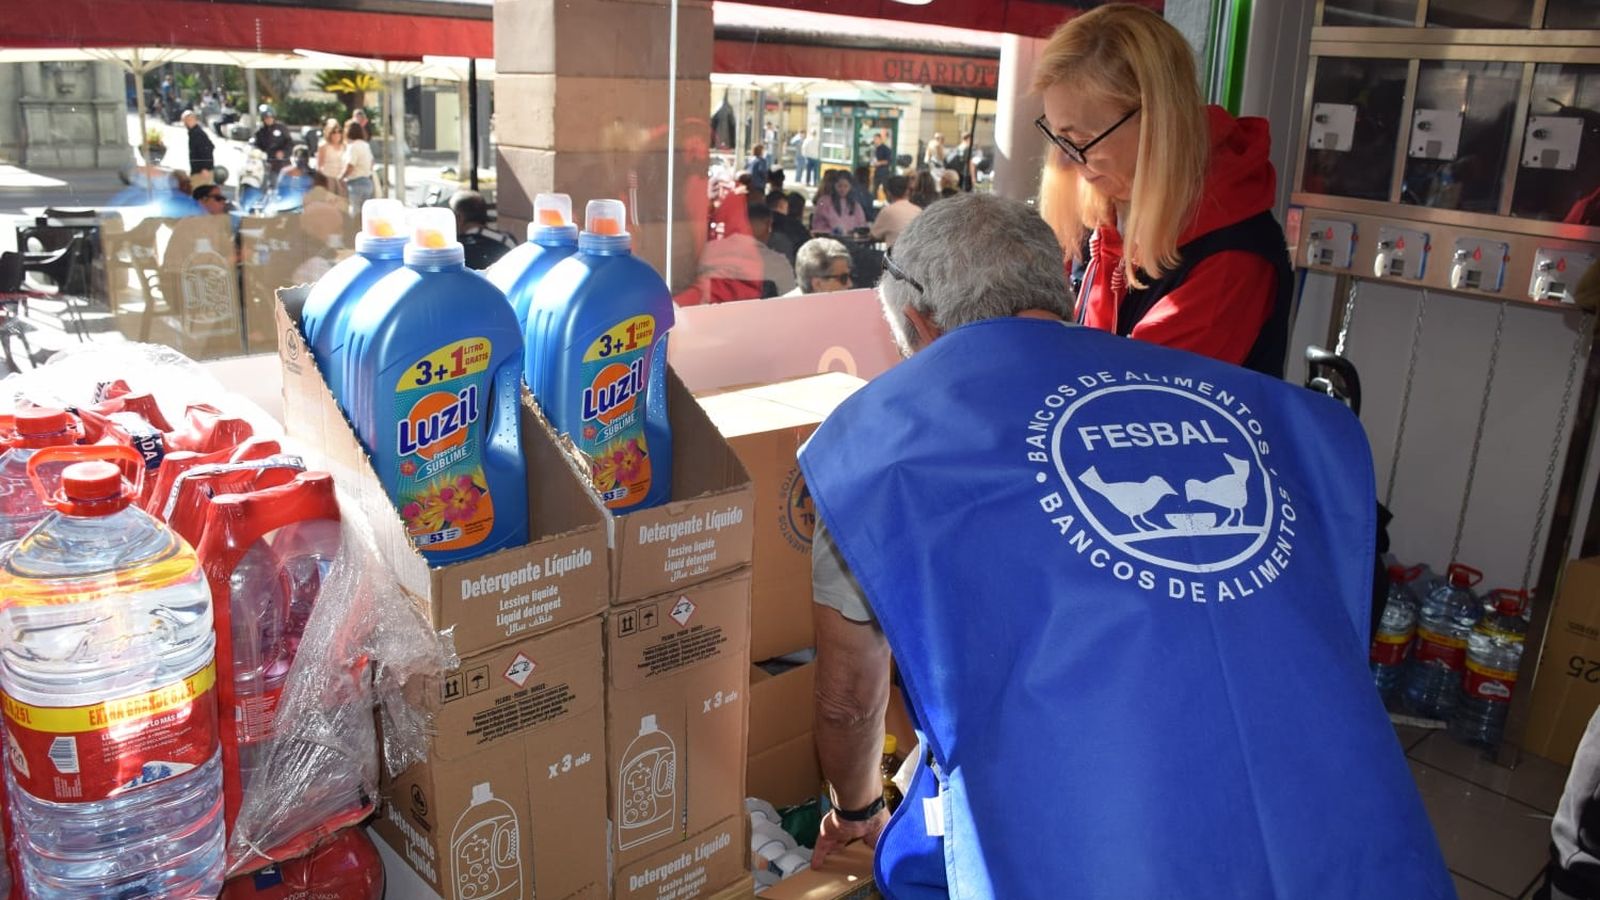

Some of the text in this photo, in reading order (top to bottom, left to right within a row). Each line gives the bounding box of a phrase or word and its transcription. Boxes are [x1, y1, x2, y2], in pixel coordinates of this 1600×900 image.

[464, 343, 484, 354] LITRO
[465, 352, 488, 365] GRATIS
[582, 357, 645, 421] Luzil
[398, 384, 479, 456] Luzil
[1026, 371, 1270, 463] BANCOS DE ALIMENTOS
[1078, 420, 1229, 450] FESBAL
[426, 446, 468, 475] SUBLIME
[430, 533, 444, 543] 53
[639, 506, 743, 544] Detergente Líquido
[1039, 486, 1297, 603] BANCOS DE ALIMENTOS
[461, 548, 592, 600] Detergente Líquido
[496, 597, 561, 626] Liquid detergent
[500, 585, 558, 611] Lessive liquide
[713, 691, 723, 708] 3
[561, 754, 573, 773] 3
[629, 832, 731, 892] Detergente Líquido
